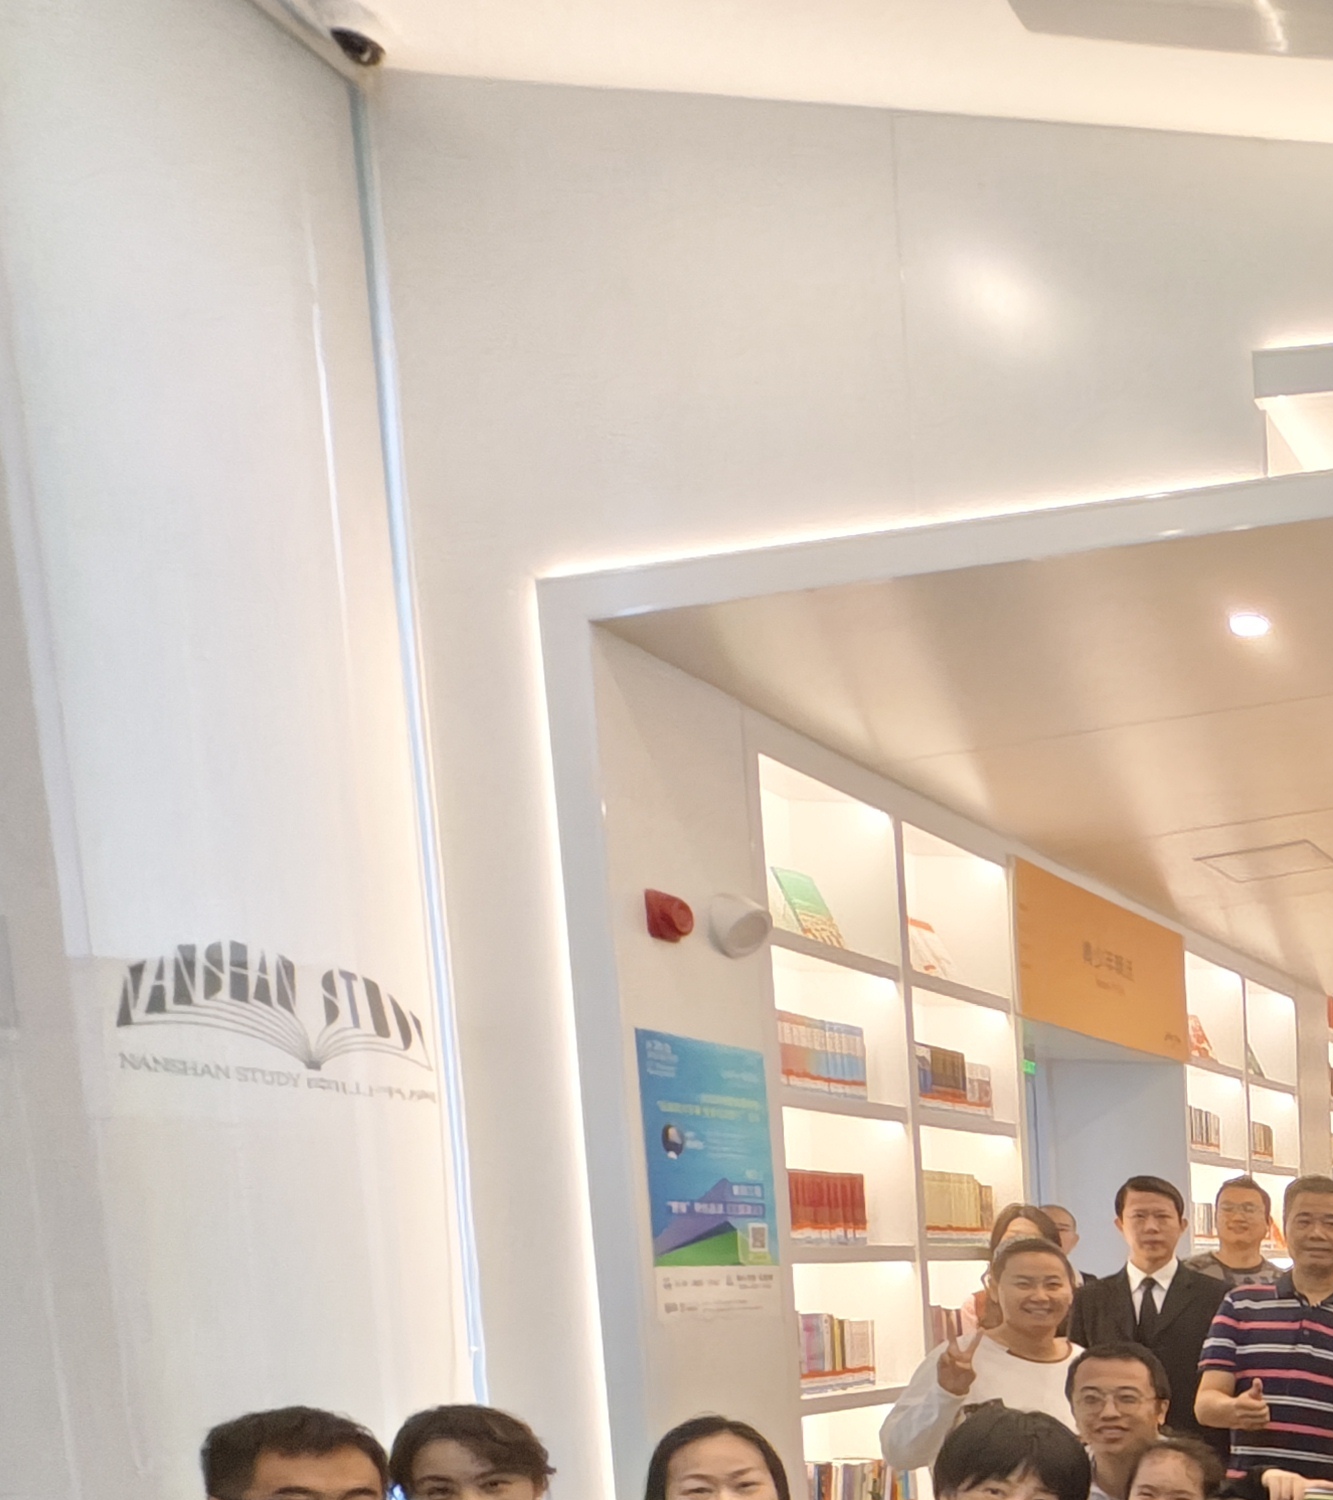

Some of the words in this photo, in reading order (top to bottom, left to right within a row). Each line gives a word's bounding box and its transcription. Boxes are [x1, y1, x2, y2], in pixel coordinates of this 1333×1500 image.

[116, 940, 297, 1027] NANSHAN
[118, 1052, 231, 1081] NANSHAN
[234, 1065, 300, 1088] STUDY
